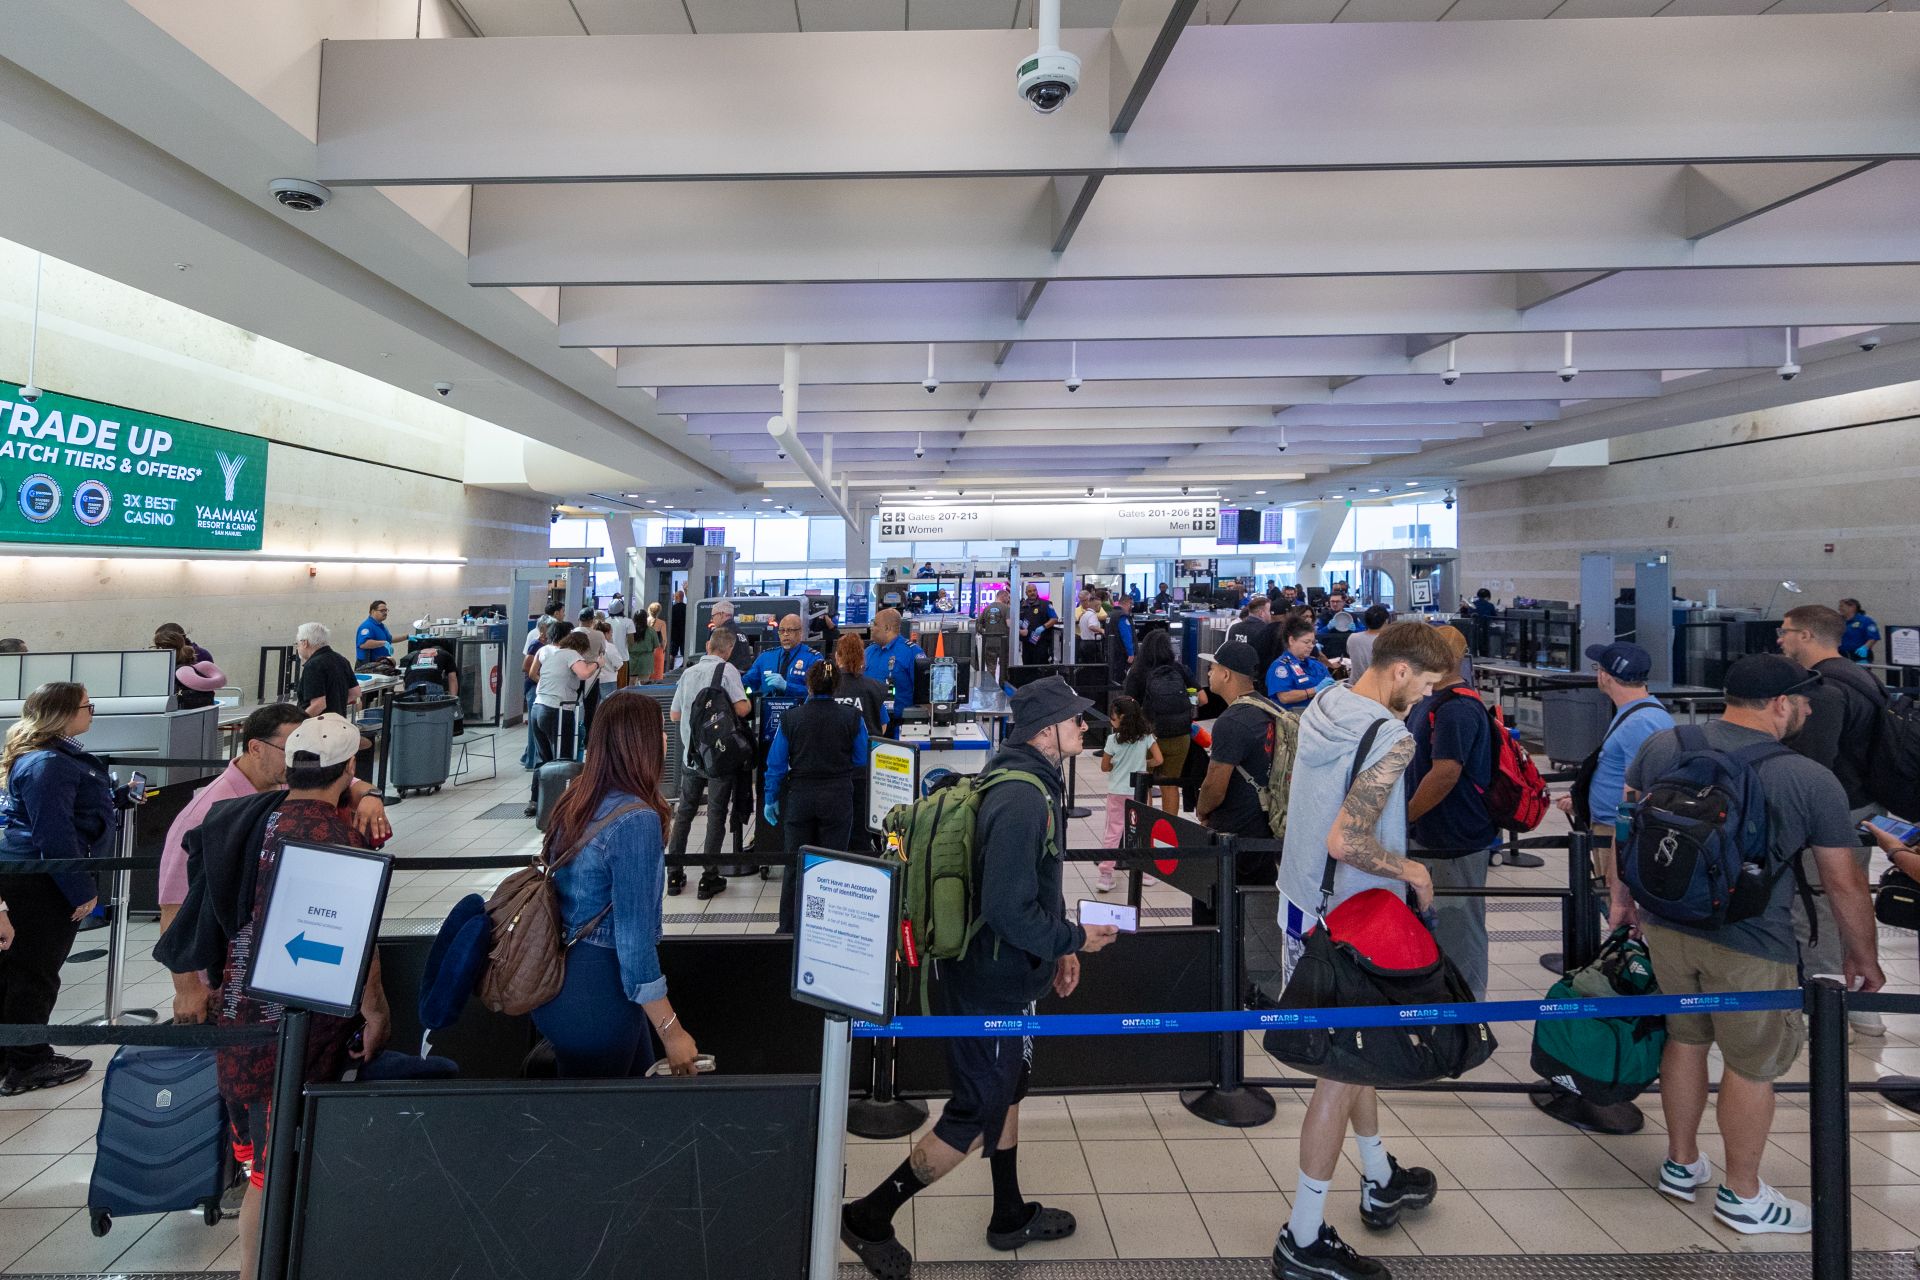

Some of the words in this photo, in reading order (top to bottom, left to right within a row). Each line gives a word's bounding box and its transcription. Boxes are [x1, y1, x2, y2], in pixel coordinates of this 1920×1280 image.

[0, 400, 121, 451] TRADE
[128, 425, 173, 458] UP
[64, 449, 116, 471] TIERS
[119, 457, 133, 473] &
[122, 494, 142, 508] 3X
[145, 496, 178, 511] BEST
[124, 510, 175, 526] CASINO
[908, 513, 936, 521] Gates
[938, 512, 978, 521] 207-213
[1118, 509, 1146, 518] Gates
[1148, 509, 1190, 517] 201-206
[197, 520, 225, 529] RESORT
[226, 522, 231, 530] &
[231, 523, 256, 531] CASINO
[908, 526, 943, 534] Women
[1169, 522, 1190, 530] Men
[1418, 591, 1425, 600] 2
[834, 697, 864, 712] TSA
[817, 876, 830, 884] Don't
[831, 879, 843, 887] Have
[851, 883, 877, 894] Acceptable
[820, 884, 832, 892] Form
[839, 889, 875, 901] Identification?
[307, 906, 338, 919] ENTER
[1680, 996, 1720, 1005] ONTARIO
[1539, 1003, 1579, 1011] ONTARIO
[1399, 1009, 1439, 1017] ONTARIO
[1122, 1018, 1161, 1026] ONTARIO
[1260, 1014, 1299, 1022] ONTARIO
[984, 1020, 1023, 1028] ONTARIO
